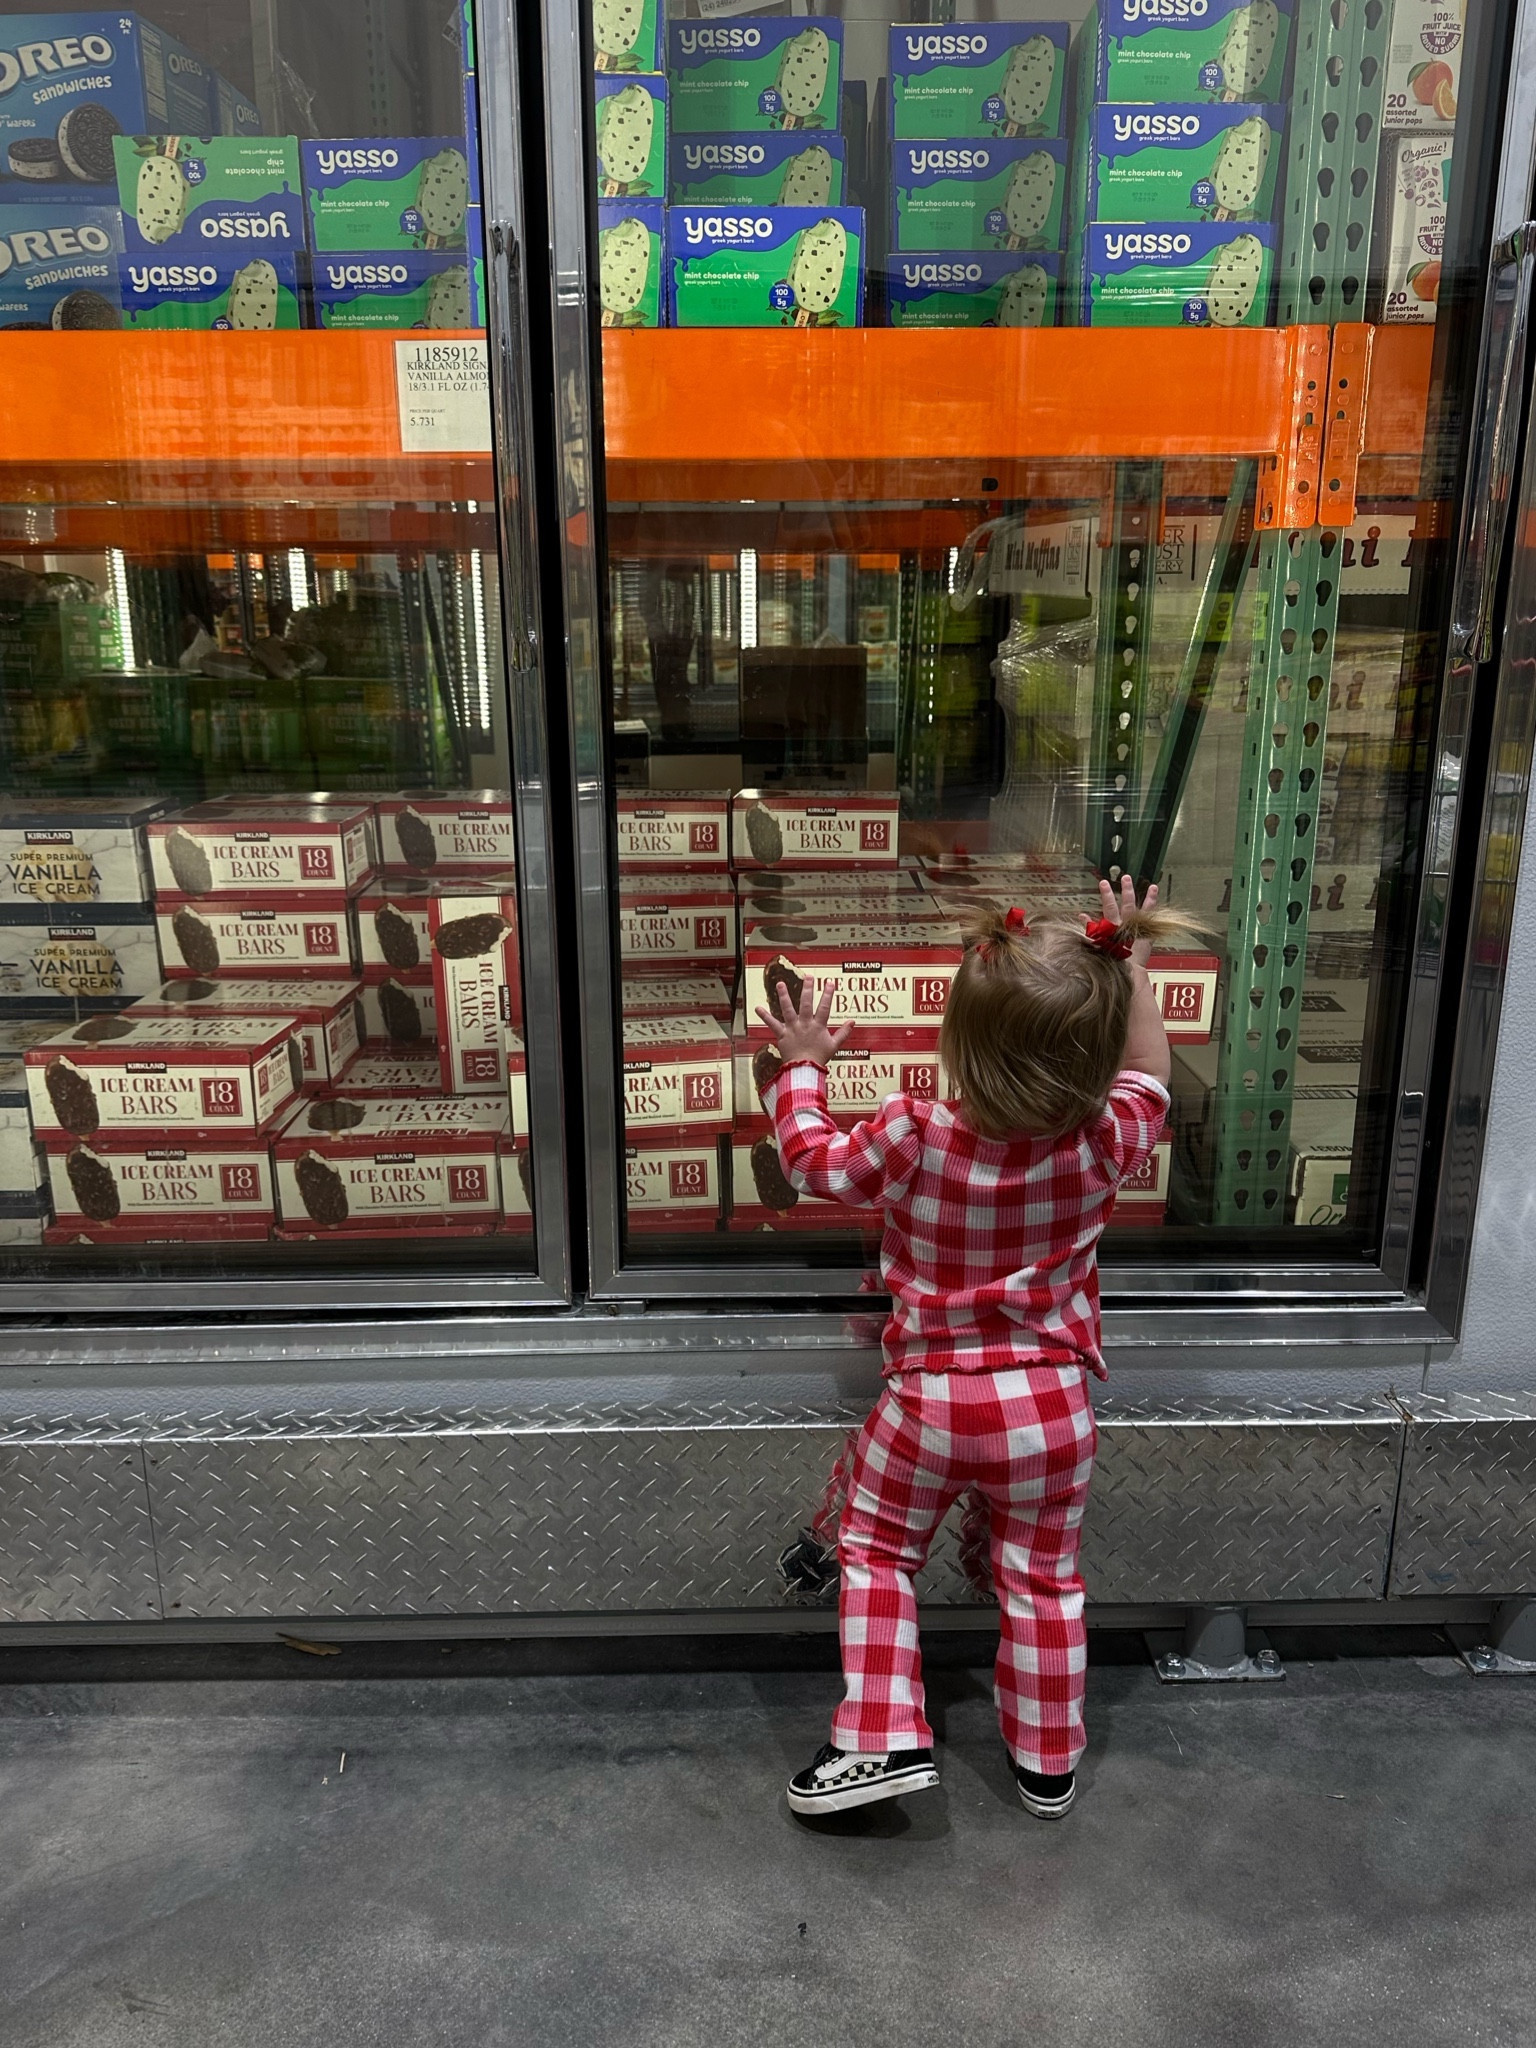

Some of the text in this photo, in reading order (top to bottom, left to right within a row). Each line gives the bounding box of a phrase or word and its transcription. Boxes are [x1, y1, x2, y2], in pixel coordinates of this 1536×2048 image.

[119, 19, 132, 28] 24
[1433, 13, 1454, 22] 100%
[1422, 23, 1461, 31] FRUIT JUICE
[678, 28, 761, 54] yasso
[906, 35, 988, 61] yasso
[1435, 37, 1445, 45] NO
[1206, 78, 1215, 87] 5g
[1387, 94, 1406, 107] 20
[1113, 114, 1199, 141] yasso
[1384, 117, 1404, 125] junior
[316, 149, 399, 174] yasso
[684, 144, 765, 169] yasso
[909, 150, 989, 174] yasso
[1109, 169, 1182, 178] mint chocolate chip
[1198, 196, 1207, 204] 5g
[200, 211, 290, 238] yasso
[684, 217, 773, 243] yasso
[1104, 233, 1191, 260] yasso
[128, 266, 217, 293] yasso
[326, 265, 407, 290] yasso
[743, 272, 760, 280] chip
[903, 264, 982, 288] yasso
[1159, 287, 1174, 295] chip
[776, 298, 787, 306] 5g
[1388, 293, 1406, 305] 20
[1190, 312, 1199, 320] 5g
[1386, 312, 1406, 320] junior
[416, 347, 478, 362] 1185912
[407, 362, 460, 370] KIRKLAND
[408, 372, 453, 380] VANILLA
[409, 383, 434, 391] 18/3.1
[438, 383, 450, 391] FL
[453, 383, 467, 391] OZ
[410, 417, 435, 426] 5.731
[439, 824, 510, 835] ICE CREAM
[639, 823, 684, 833] CREAM
[787, 820, 855, 831] ICE CREAM
[865, 823, 884, 840] 18
[694, 825, 713, 842] 18
[800, 834, 841, 848] BARS
[454, 838, 497, 852] BARS
[630, 836, 671, 850] BARS
[10, 852, 42, 861] SUPER
[213, 846, 294, 858] ICE CREAM
[306, 849, 328, 868] 18
[6, 864, 102, 880] VANILLA
[231, 862, 280, 878] BARS
[13, 883, 100, 895] ICE CREAM
[30, 959, 124, 975] VANILLA
[37, 977, 122, 988] ICE CREAM
[848, 978, 906, 991] CREAM
[920, 981, 944, 1002] 18
[1171, 986, 1195, 1008] 18
[459, 980, 480, 1029] BARS
[479, 962, 498, 1043] ICE CREAM
[836, 995, 889, 1013] BARS
[475, 1056, 497, 1077] 18
[836, 1065, 894, 1079] CREAM
[100, 1078, 194, 1092] ICE CREAM
[908, 1068, 931, 1088] 18
[207, 1081, 234, 1103] 18
[691, 1077, 714, 1098] 18
[826, 1082, 877, 1099] BARS
[121, 1097, 177, 1114] BARS
[691, 1100, 715, 1108] COUNT
[121, 1165, 213, 1179] ICE CREAM
[227, 1167, 253, 1188] 18
[350, 1167, 442, 1184] ICE CREAM
[455, 1169, 480, 1190] 18
[677, 1164, 700, 1184] 18
[142, 1182, 198, 1200] BARS
[371, 1185, 425, 1204] BARS
